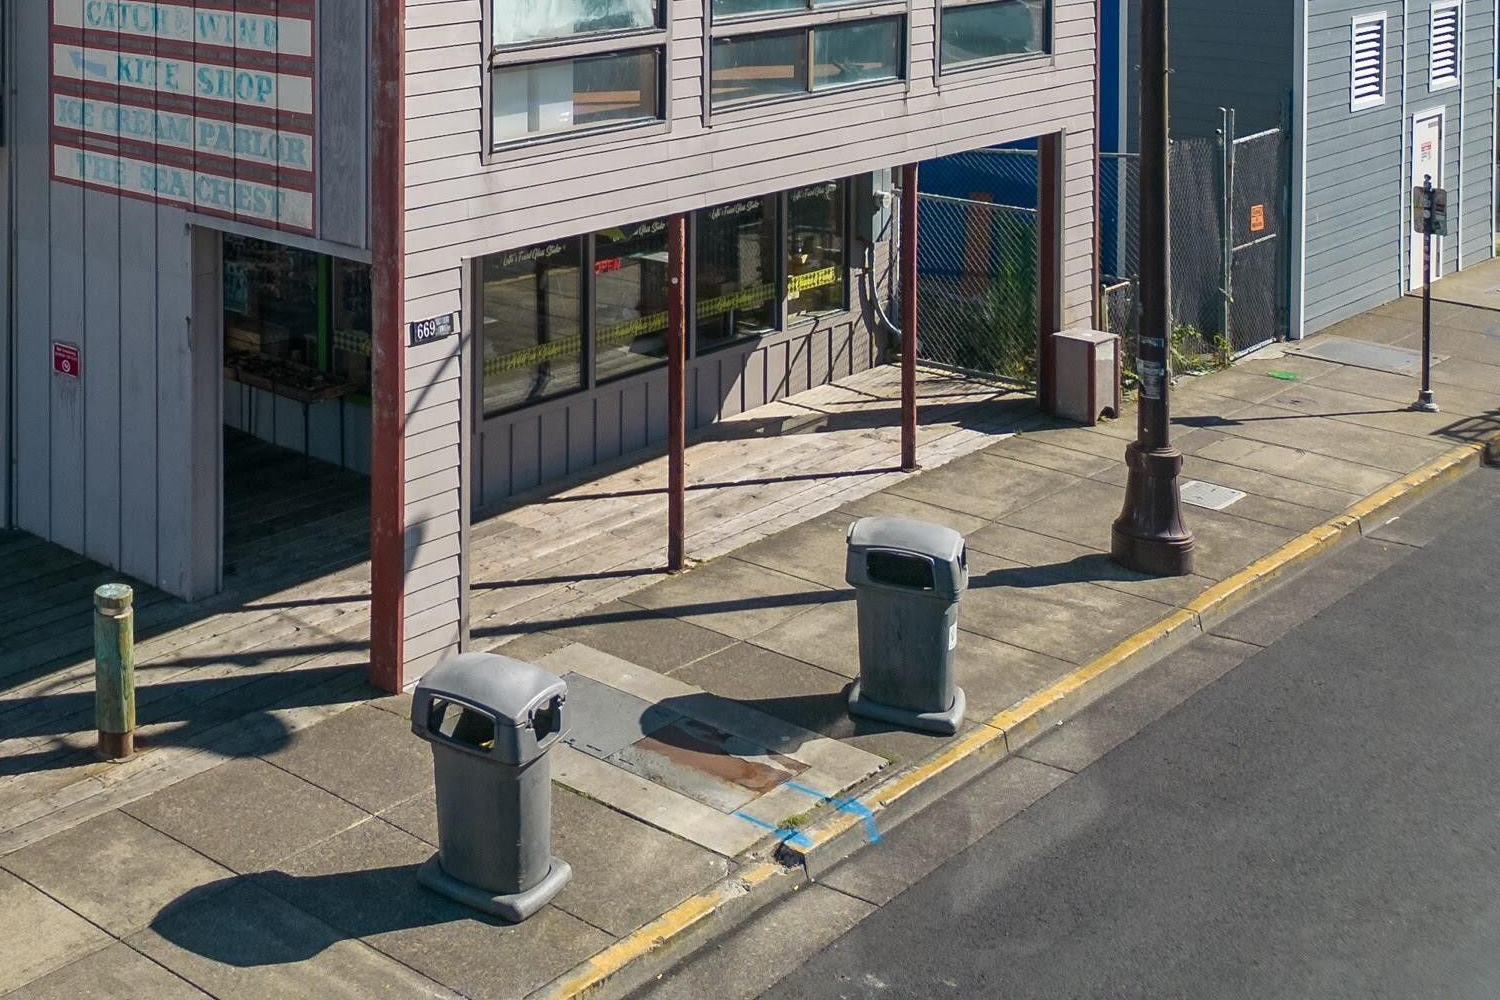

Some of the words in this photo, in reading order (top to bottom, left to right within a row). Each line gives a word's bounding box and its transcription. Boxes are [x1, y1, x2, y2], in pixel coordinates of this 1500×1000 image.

[86, 0, 168, 35] CATCH
[116, 54, 180, 91] KITE
[197, 65, 274, 103] SHOP
[58, 99, 95, 124] ICE
[101, 105, 193, 145] CREAM
[139, 166, 188, 197] SEA
[196, 173, 286, 219] CHEST
[417, 320, 436, 339] 669
